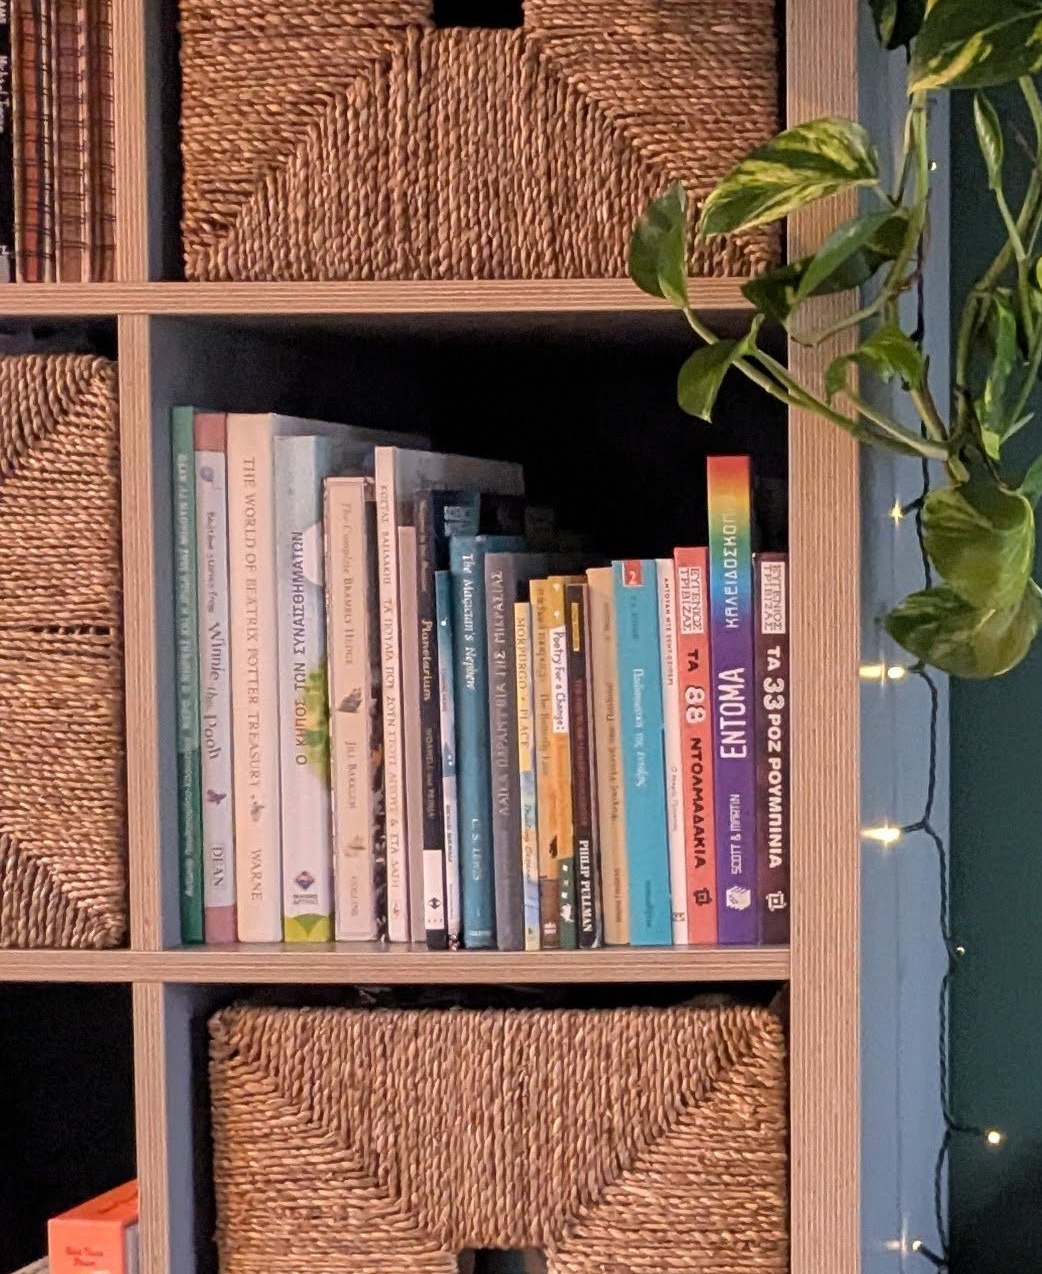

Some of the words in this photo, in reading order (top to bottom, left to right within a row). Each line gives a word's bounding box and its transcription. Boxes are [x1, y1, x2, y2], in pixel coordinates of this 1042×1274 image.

[243, 457, 257, 486] THE
[243, 494, 257, 547] WORLD
[342, 503, 352, 521] The
[245, 554, 257, 572] OF
[341, 525, 354, 575] Complete
[461, 554, 475, 574] The
[291, 531, 305, 655] ΣΥΝΑΙΣΘΗΜΑΤΩΝ
[628, 570, 637, 585] 2
[245, 579, 259, 642] BEATRIX
[382, 598, 393, 614] ΤΑ
[461, 579, 477, 642] Magician's
[680, 568, 692, 631] ΤΡΙΒΙΖΑΣ
[690, 568, 702, 631] ΕΥΓΕΝΙΟΣ
[763, 564, 774, 632] ΤΡΙΒΙΖΑΣ
[773, 564, 783, 632] ΕΥΓΕΝΙΟΣ
[208, 622, 226, 681] Winnie
[421, 619, 433, 701] Planetarium
[516, 618, 528, 689] MORPURGO
[552, 632, 566, 664] Poetry
[687, 649, 700, 672] ΤΑ
[766, 645, 782, 672] ΤΑ
[247, 648, 260, 704] POTTER
[293, 662, 305, 691] ΤΩΝ
[385, 666, 396, 690] ΠΟΥ
[464, 647, 479, 691] Nephew
[554, 666, 565, 682] For
[386, 695, 397, 727] ΖΟΥΝ
[552, 692, 567, 730] Change:
[684, 686, 706, 724] 88
[762, 676, 786, 711] 33
[294, 700, 307, 747] ΚΗΠΟΣ
[519, 709, 530, 748] PLACE
[718, 668, 748, 759] ΕΝΤΟΜΑ
[767, 713, 782, 753] ΡΟΖ
[204, 714, 221, 760] Pooh
[248, 712, 261, 787] TREASURY
[295, 754, 308, 765] Ο
[389, 818, 399, 827] &
[690, 737, 706, 869] ΝΤΟΛΜΑΔΑΚΙΑ
[728, 793, 742, 832] MARTIN
[767, 757, 783, 869] ΡΟΥΜΠΙΝΙΑ
[390, 833, 400, 855] ΣΤΑ
[729, 833, 742, 841] &
[212, 846, 225, 886] DEAN
[250, 849, 263, 901] WARNE
[472, 848, 482, 881] LEWIS
[578, 839, 591, 877] PHILIP
[729, 843, 743, 875] SCOTT
[580, 880, 593, 932] PULLMAN
